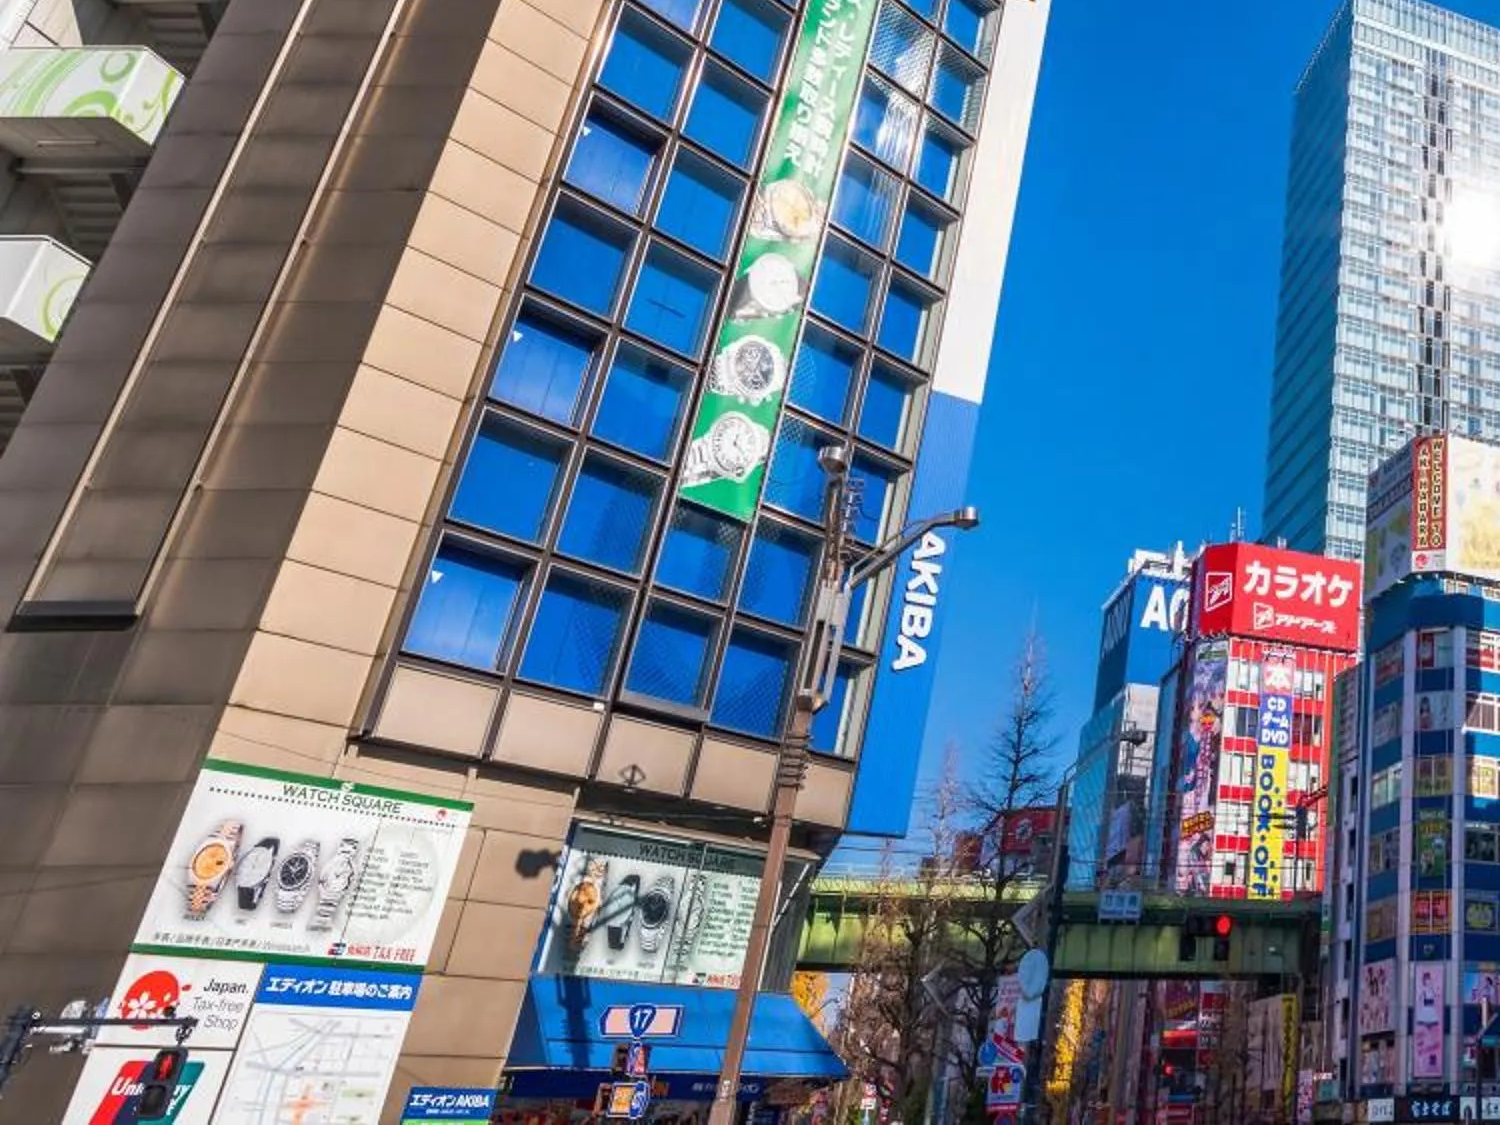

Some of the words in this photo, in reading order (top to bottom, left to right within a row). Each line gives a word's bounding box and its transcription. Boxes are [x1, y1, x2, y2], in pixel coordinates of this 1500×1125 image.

[1243, 561, 1354, 607] カラオケ
[892, 531, 946, 673] AKIBA
[1264, 662, 1291, 689] 本
[1266, 696, 1288, 712] CD
[1262, 712, 1290, 728] ゲーム
[1262, 729, 1289, 745] DVD
[282, 784, 340, 805] WATCH
[342, 793, 404, 815] SQUARE
[639, 842, 685, 861] WATCH
[394, 946, 417, 962] FREE
[203, 978, 249, 996] Japan.
[265, 976, 329, 994] エディオン
[330, 978, 413, 1000] 駐車場のご案内
[193, 996, 245, 1012] Tax-free
[204, 1014, 239, 1031] Shop
[633, 1010, 650, 1031] 17
